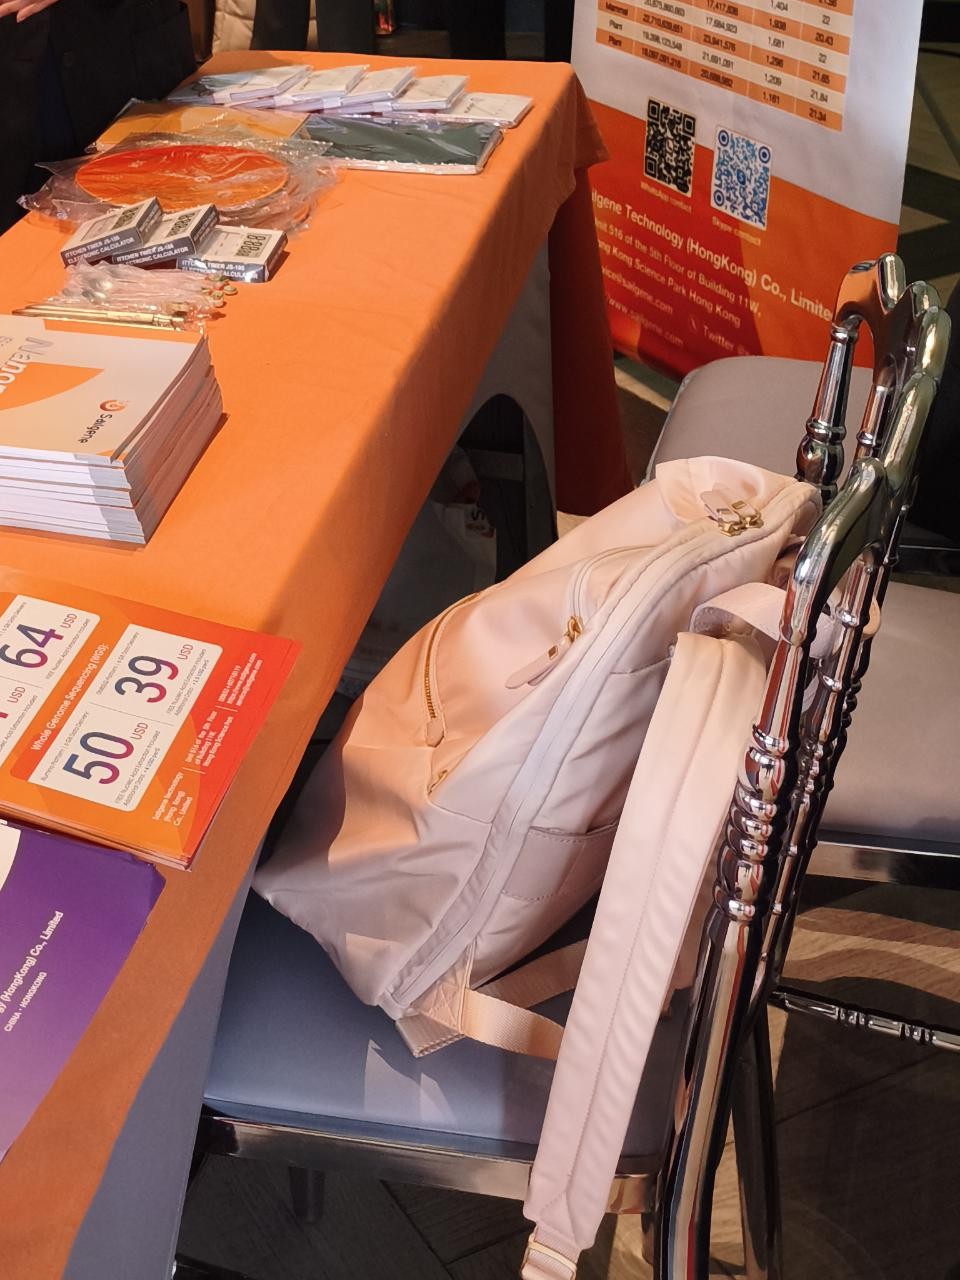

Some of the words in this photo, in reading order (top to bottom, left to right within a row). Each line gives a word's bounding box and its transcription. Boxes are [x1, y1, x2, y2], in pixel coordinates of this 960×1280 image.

[612, 246, 634, 267] Kong
[634, 257, 666, 284] Science
[668, 276, 686, 296] Park
[689, 290, 713, 313] Hong
[715, 301, 741, 329] Kong
[625, 204, 684, 250] Technology
[687, 238, 757, 288] (HongKong)
[760, 273, 787, 303] Co.,
[790, 287, 834, 322] Limite
[635, 238, 648, 254] the
[687, 269, 697, 282] of
[698, 272, 736, 303] Building
[77, 412, 114, 445] Sailgene
[60, 613, 78, 629] USD
[7, 686, 27, 704] USD
[114, 655, 179, 704] 39
[176, 644, 194, 661] USD
[31, 727, 53, 752] Whole
[46, 698, 71, 730] Genome
[64, 666, 94, 701] Sequencing
[62, 731, 135, 785] 50
[130, 722, 149, 740] USD
[0, 956, 38, 1003] (HongKong)
[40, 910, 64, 941] Limited
[4, 1011, 22, 1032] CHINA
[20, 971, 48, 1009] HONGKONG
